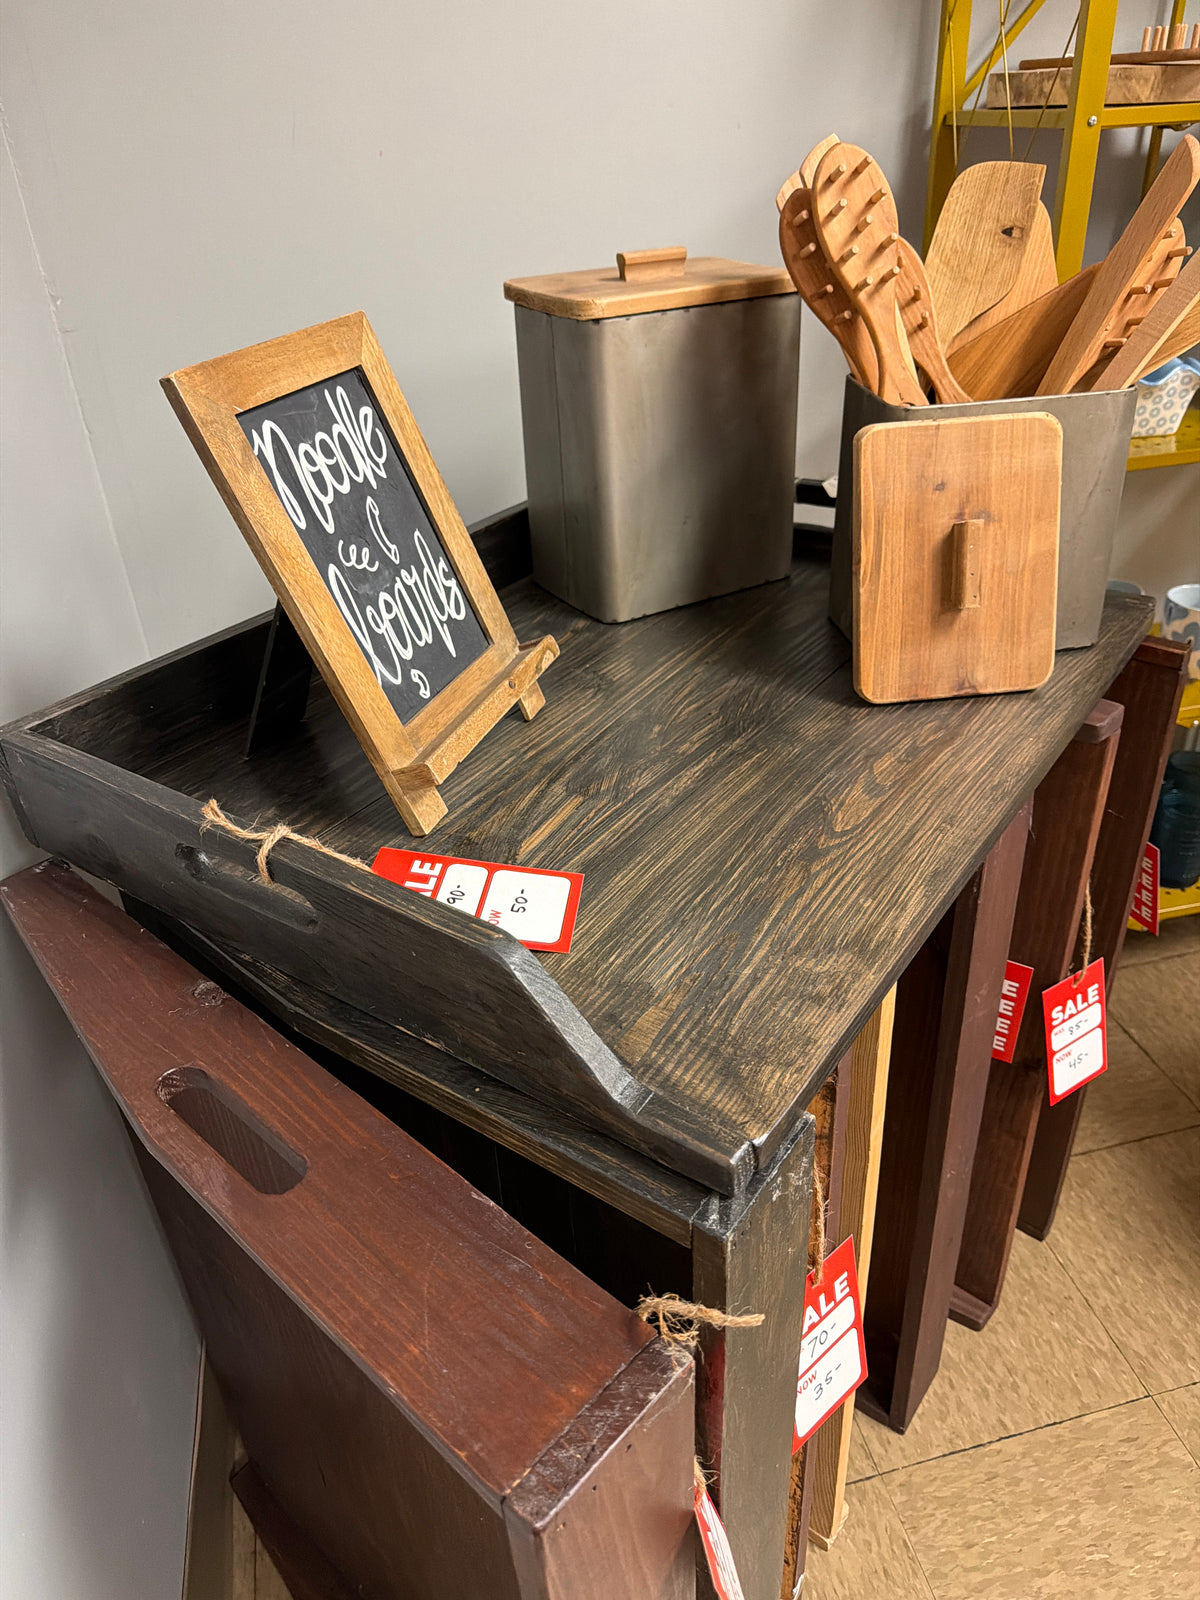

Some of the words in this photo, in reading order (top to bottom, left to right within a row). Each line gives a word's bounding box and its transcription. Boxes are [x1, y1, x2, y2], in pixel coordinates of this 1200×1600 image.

[404, 859, 443, 897] LE
[510, 888, 528, 914] 50-
[487, 909, 502, 926] OW
[1051, 983, 1100, 1026] SALE
[1055, 1049, 1072, 1064] NOW
[802, 1271, 850, 1336] ALE
